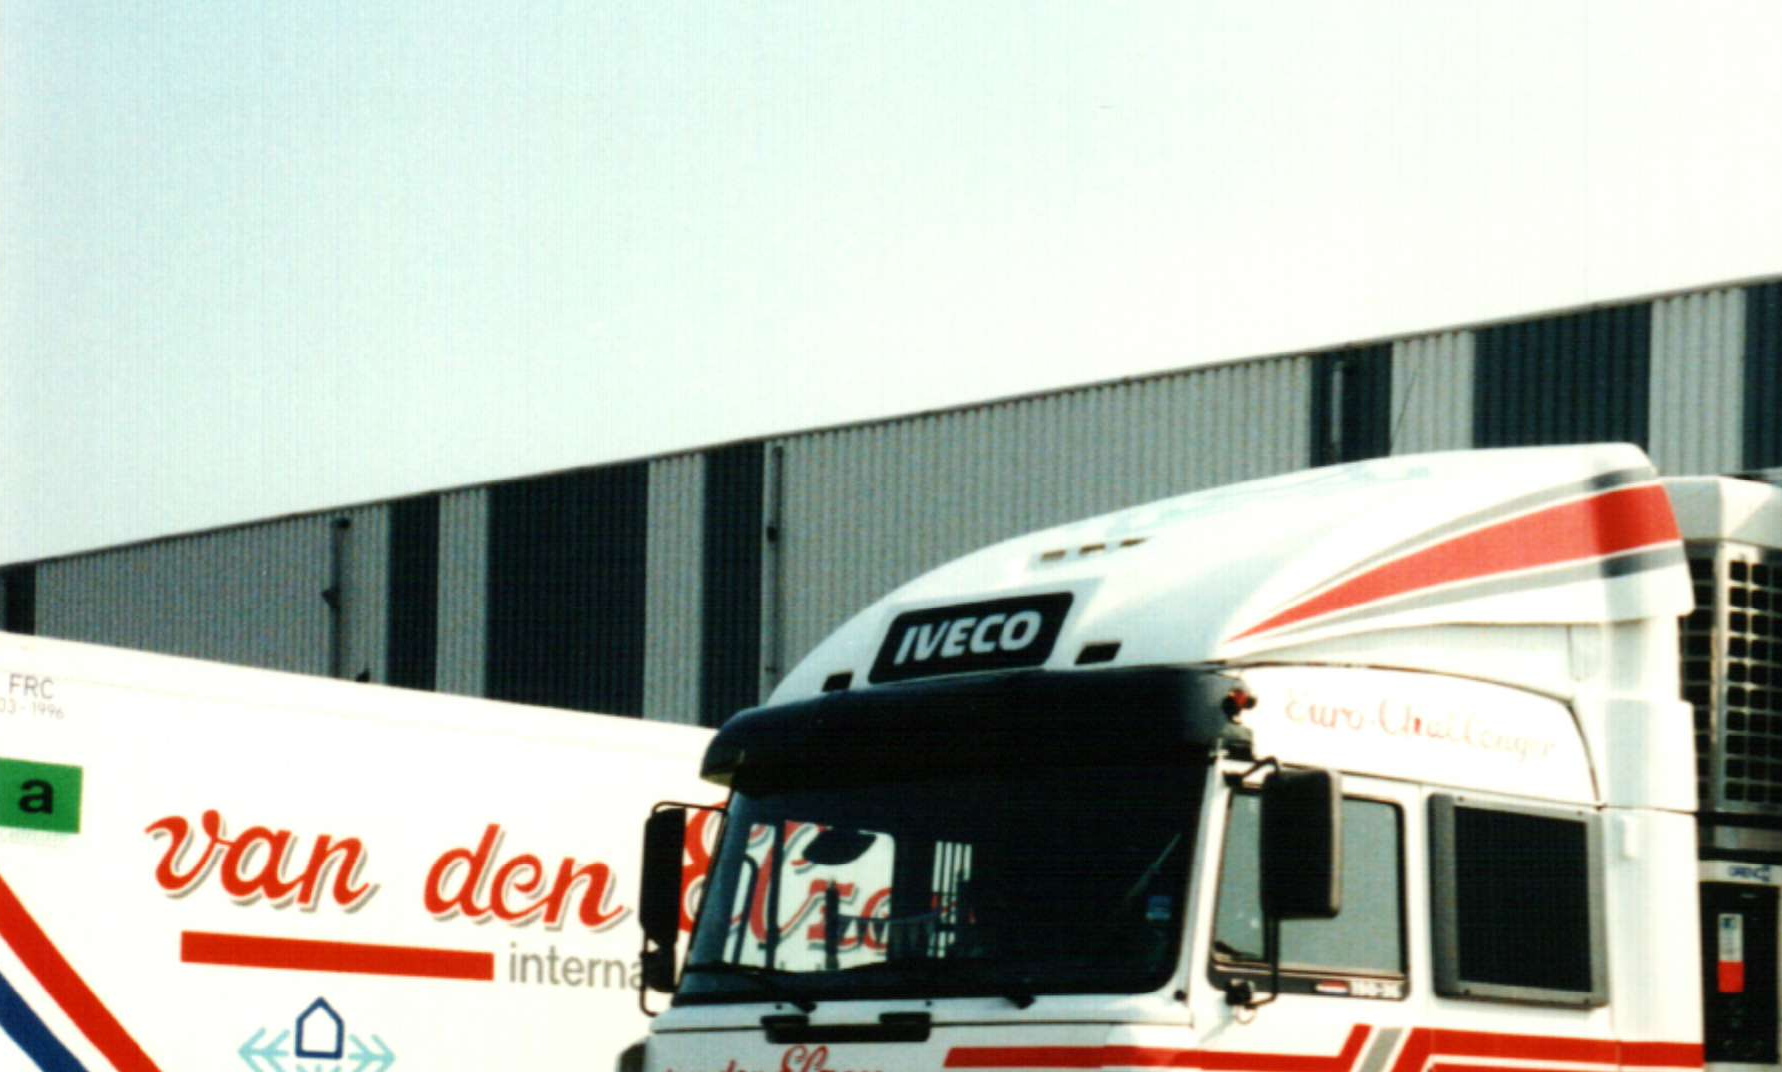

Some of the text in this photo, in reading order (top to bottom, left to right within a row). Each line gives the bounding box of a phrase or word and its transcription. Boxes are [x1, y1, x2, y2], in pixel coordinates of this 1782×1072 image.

[895, 609, 1041, 666] IVECO
[9, 673, 55, 700] FRC
[19, 778, 54, 815] a
[145, 810, 378, 912] van
[424, 824, 632, 930] den
